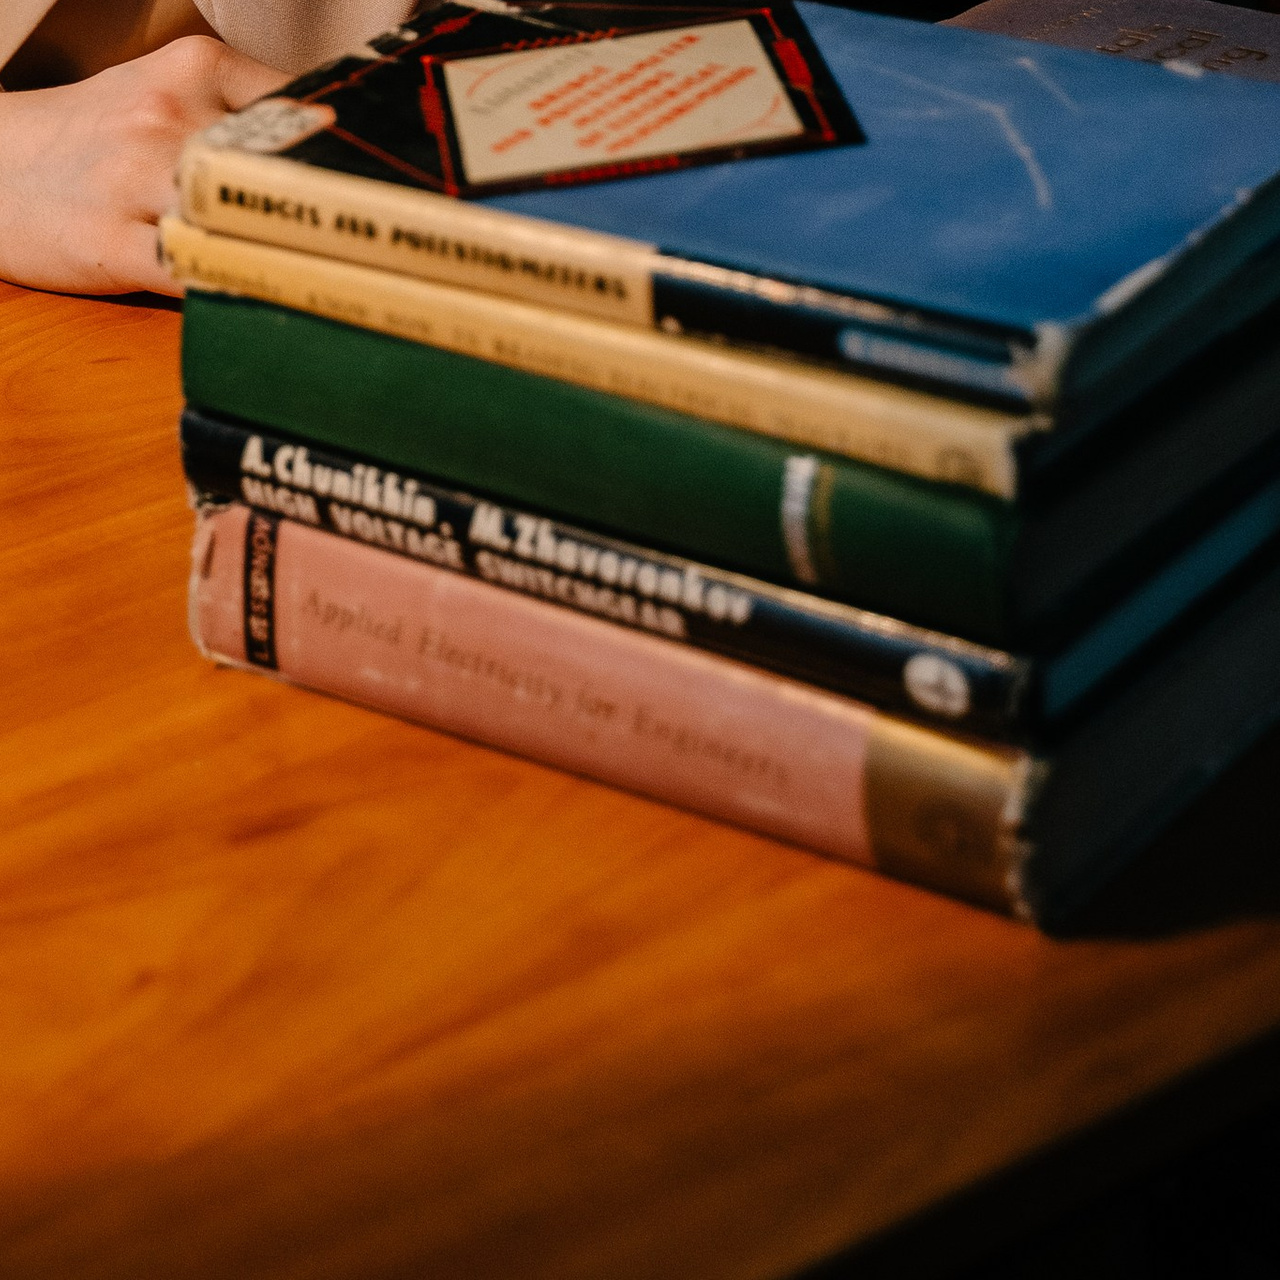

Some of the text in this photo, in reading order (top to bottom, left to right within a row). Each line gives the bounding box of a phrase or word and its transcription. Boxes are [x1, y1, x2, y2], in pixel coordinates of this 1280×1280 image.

[218, 185, 321, 228] BRIDGES
[241, 475, 320, 524] HIGH
[329, 501, 466, 571] VOLTAGE
